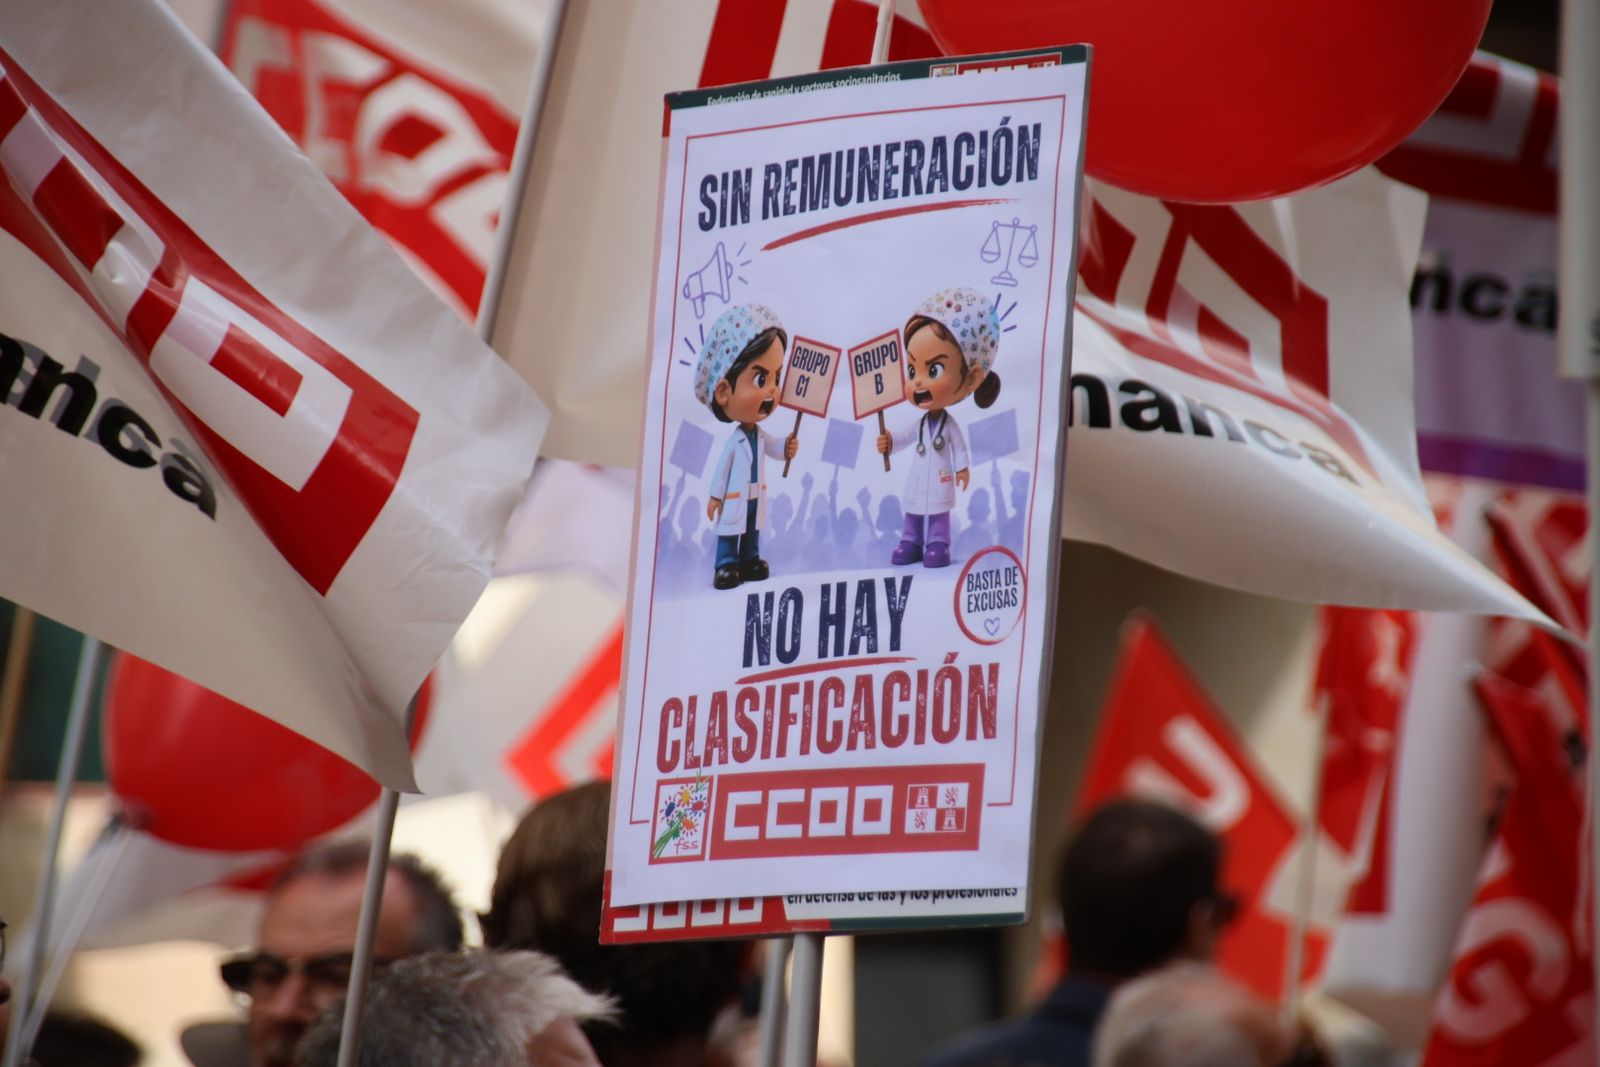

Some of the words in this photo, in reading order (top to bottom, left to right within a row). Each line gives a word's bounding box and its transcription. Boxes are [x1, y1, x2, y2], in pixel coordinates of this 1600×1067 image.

[707, 91, 750, 106] Federación
[751, 89, 762, 100] de
[763, 83, 794, 98] sanidad
[801, 80, 834, 93] sectores
[836, 71, 902, 87] sociosanitarios
[699, 167, 753, 231] SIN
[761, 116, 1041, 221] REMUNERACIÓN
[792, 346, 831, 377] GRUPO
[854, 340, 899, 377] GRUPO
[795, 374, 811, 398] C1
[874, 373, 885, 396] B
[966, 568, 1002, 593] BASTA
[1004, 566, 1019, 587] DE
[967, 587, 1018, 613] EXCUSAS
[742, 587, 804, 668] NO
[817, 575, 914, 659] HAY
[656, 652, 1000, 774] CLASIFICACIÓN
[724, 785, 894, 842] CCOO
